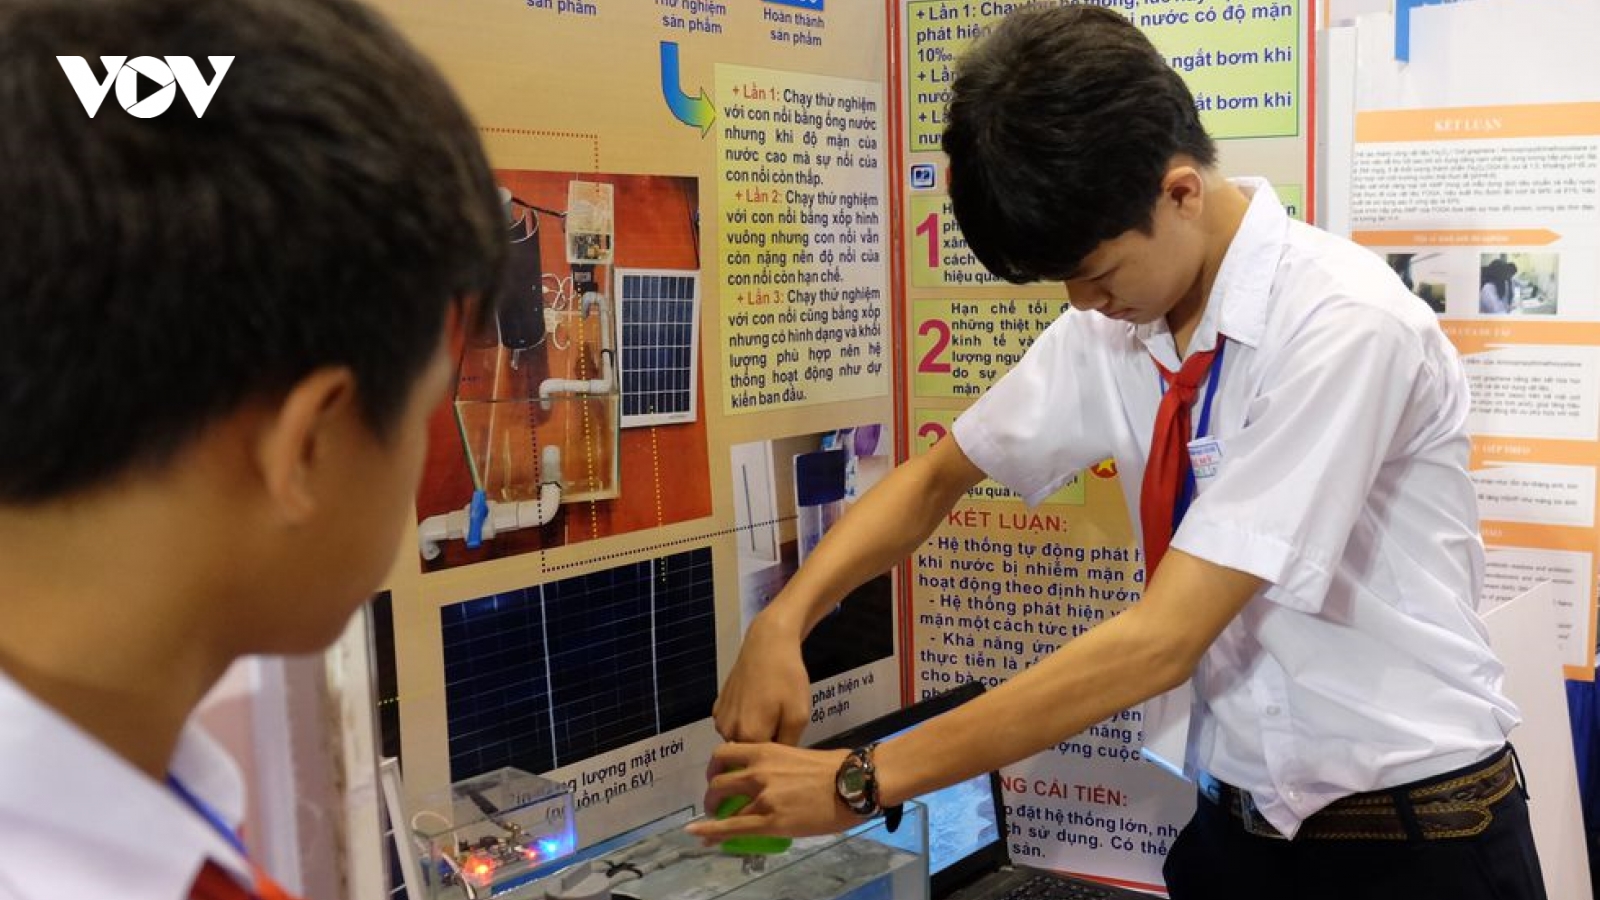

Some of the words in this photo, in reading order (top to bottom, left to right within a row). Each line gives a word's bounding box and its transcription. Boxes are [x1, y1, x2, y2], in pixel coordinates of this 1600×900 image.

[1141, 11, 1189, 27] nước
[1195, 9, 1216, 22] có
[1223, 5, 1245, 23] độ
[1252, 3, 1292, 22] mặn
[1172, 48, 1212, 71] ngắt
[1217, 50, 1258, 66] bơm
[1264, 47, 1291, 62] khi
[1217, 95, 1258, 111] bơm
[1264, 92, 1291, 107] khi
[916, 212, 939, 268] 1
[918, 318, 952, 373] 2
[949, 508, 991, 528] KẾT
[1000, 510, 1067, 534] LUẬN:
